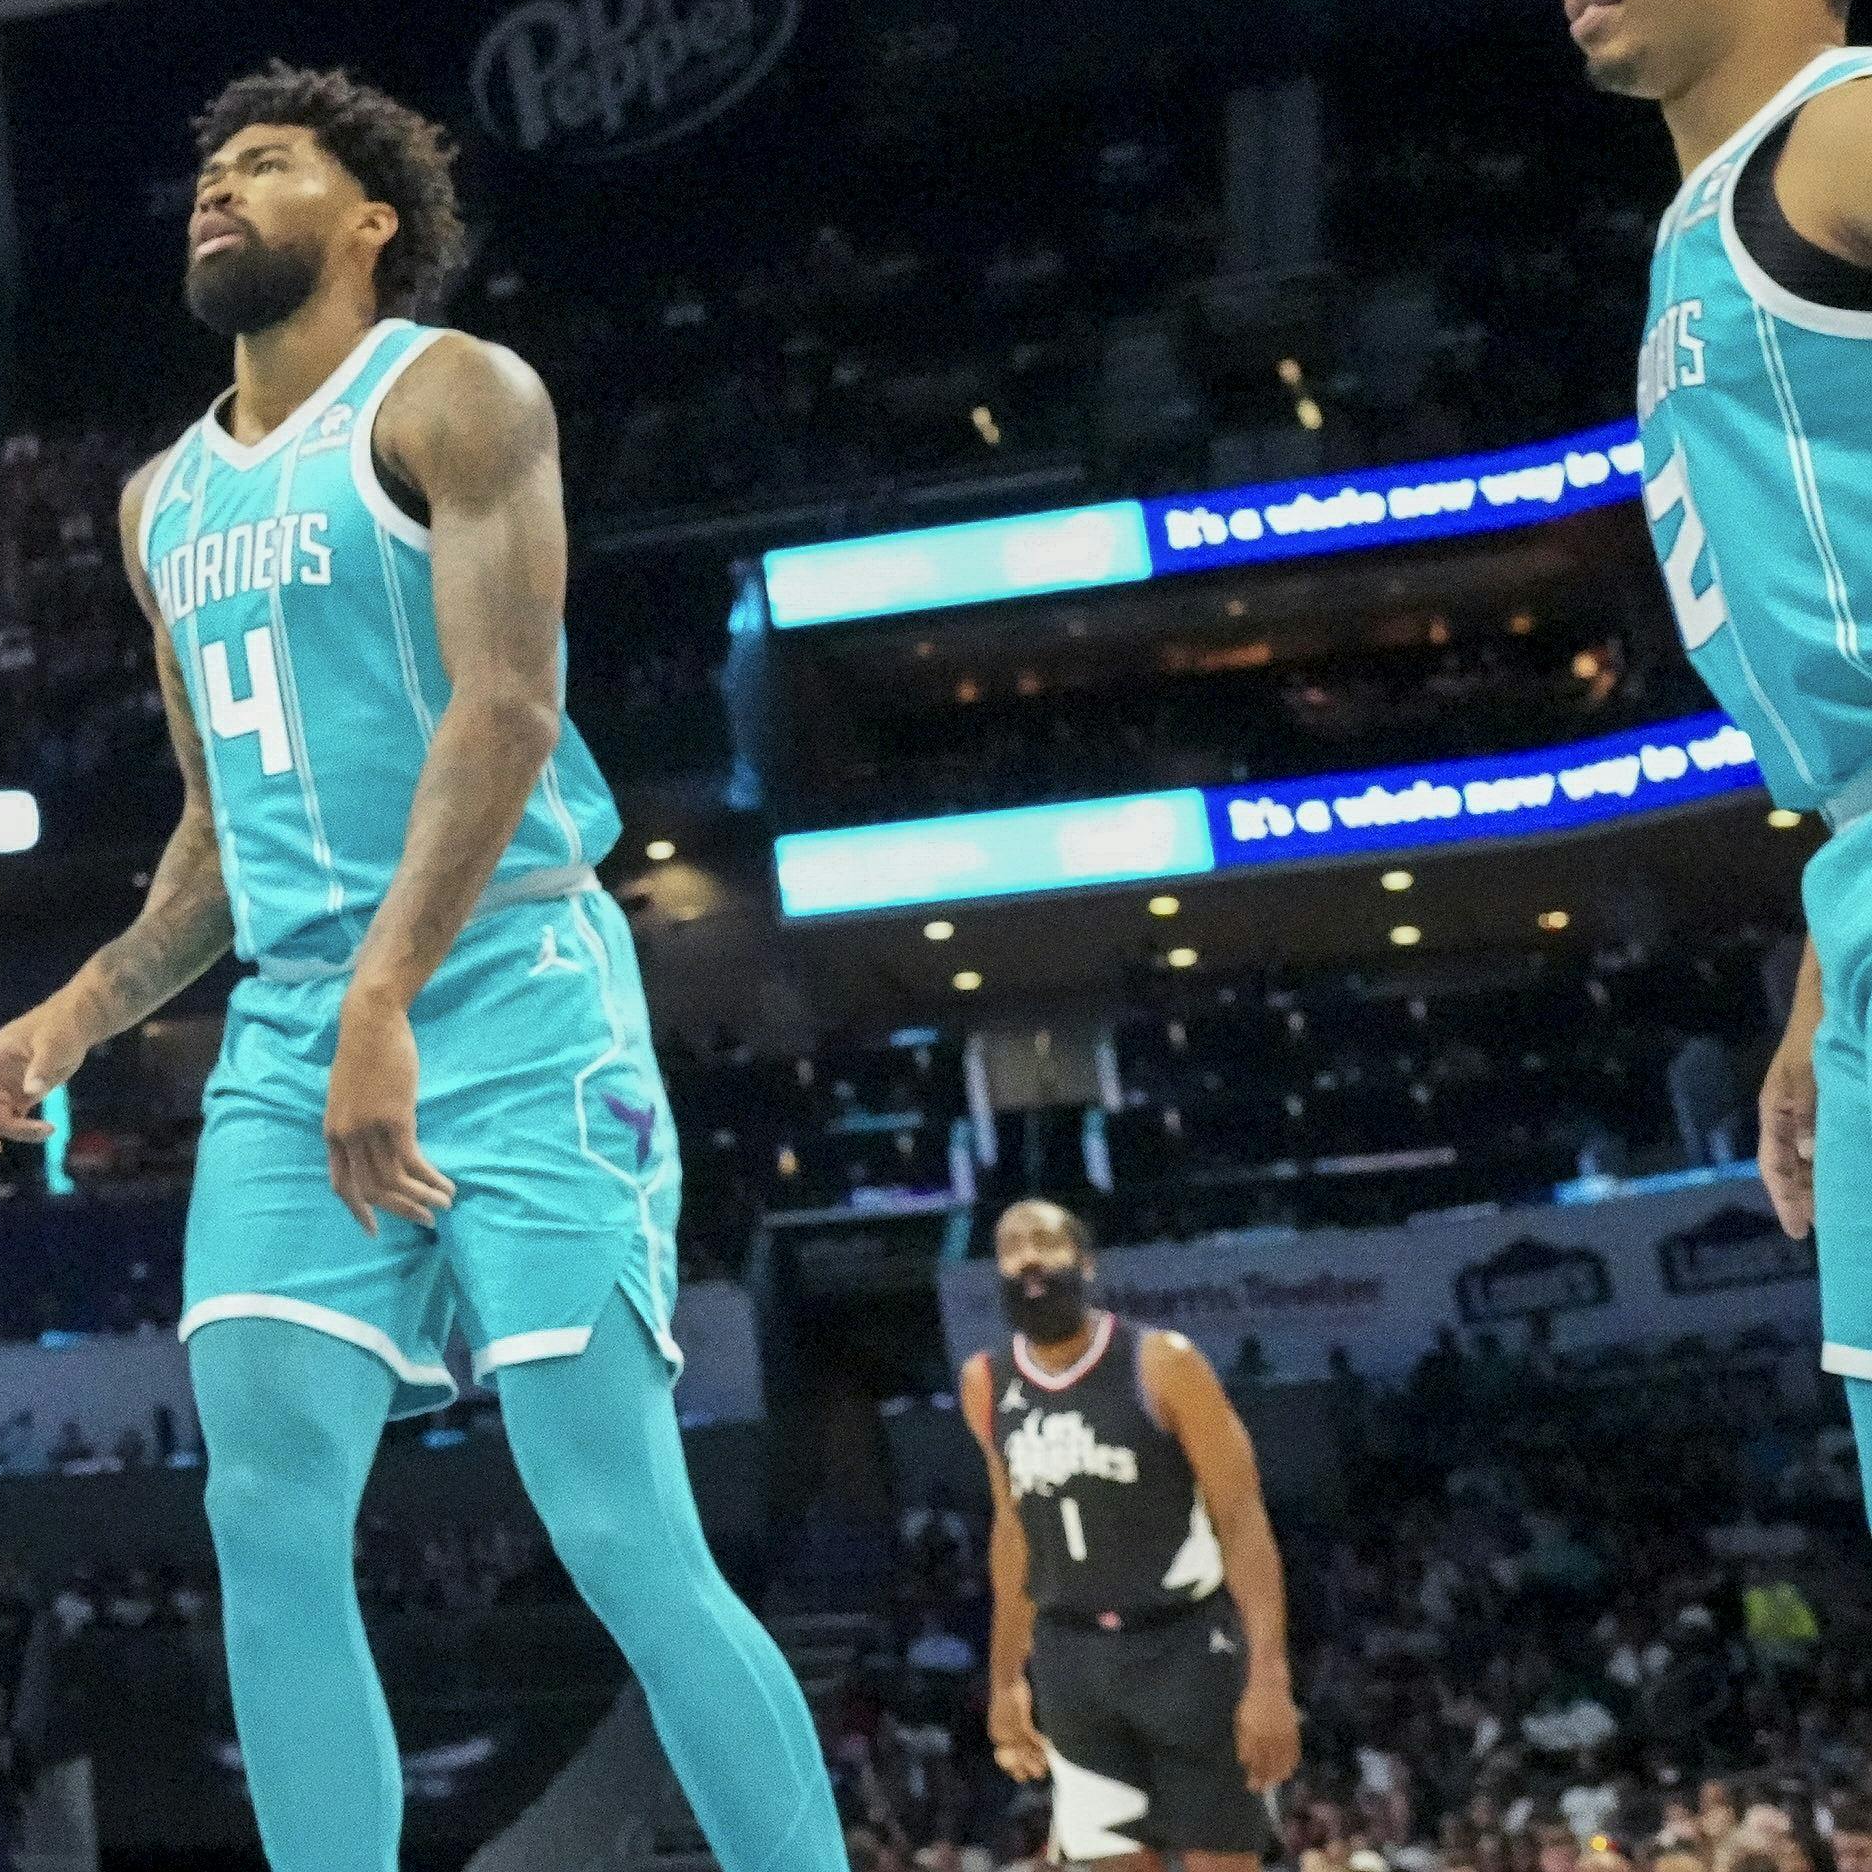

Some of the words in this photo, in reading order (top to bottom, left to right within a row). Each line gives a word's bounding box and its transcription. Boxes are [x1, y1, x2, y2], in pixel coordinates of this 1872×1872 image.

[1478, 462, 1564, 505] way
[1564, 451, 1610, 488] to
[155, 512, 334, 625] HORNETS
[202, 627, 294, 776] 4
[1333, 780, 1462, 828] whole
[1463, 774, 1555, 814] new
[1558, 756, 1641, 799] way
[1640, 745, 1688, 782] to
[1059, 1495, 1087, 1561] 1
